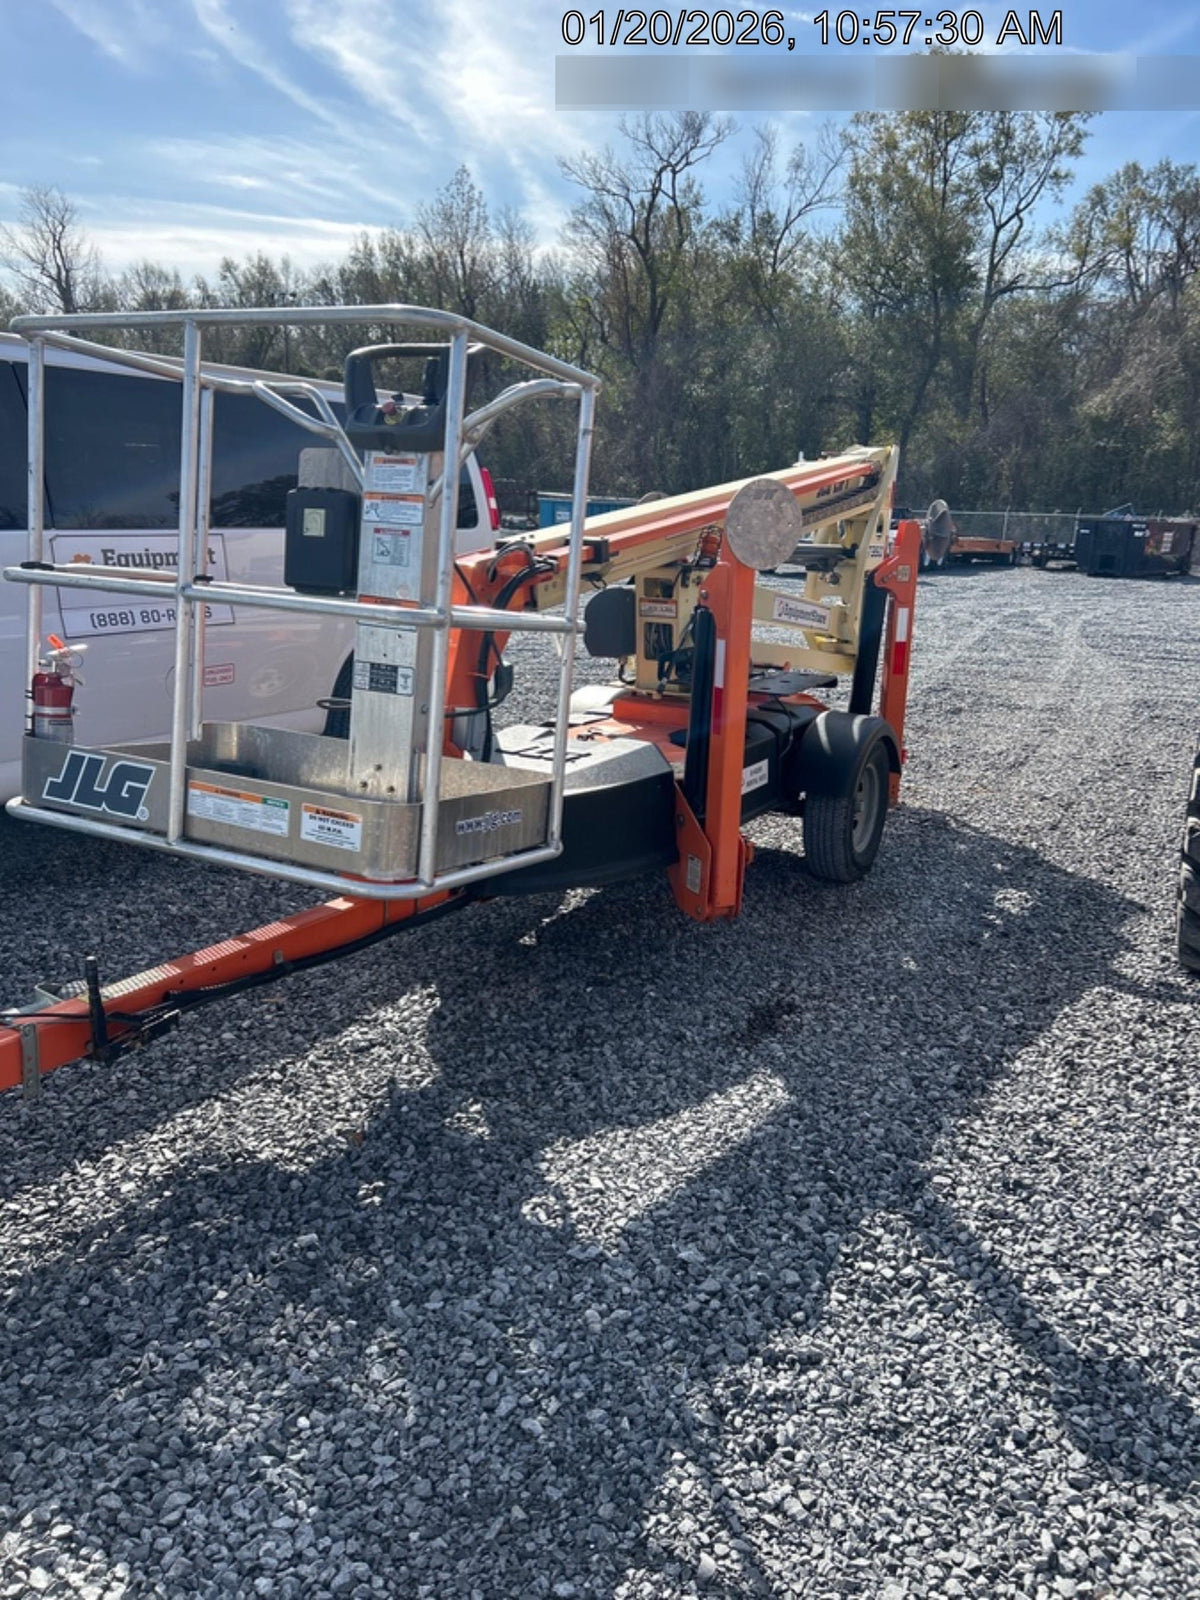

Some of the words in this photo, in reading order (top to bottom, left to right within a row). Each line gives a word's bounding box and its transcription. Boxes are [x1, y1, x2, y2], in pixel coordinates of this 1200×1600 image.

[101, 547, 217, 570] Equipmt
[90, 611, 136, 629] (888)
[141, 606, 213, 624] 80-RS
[42, 750, 157, 819] JLG
